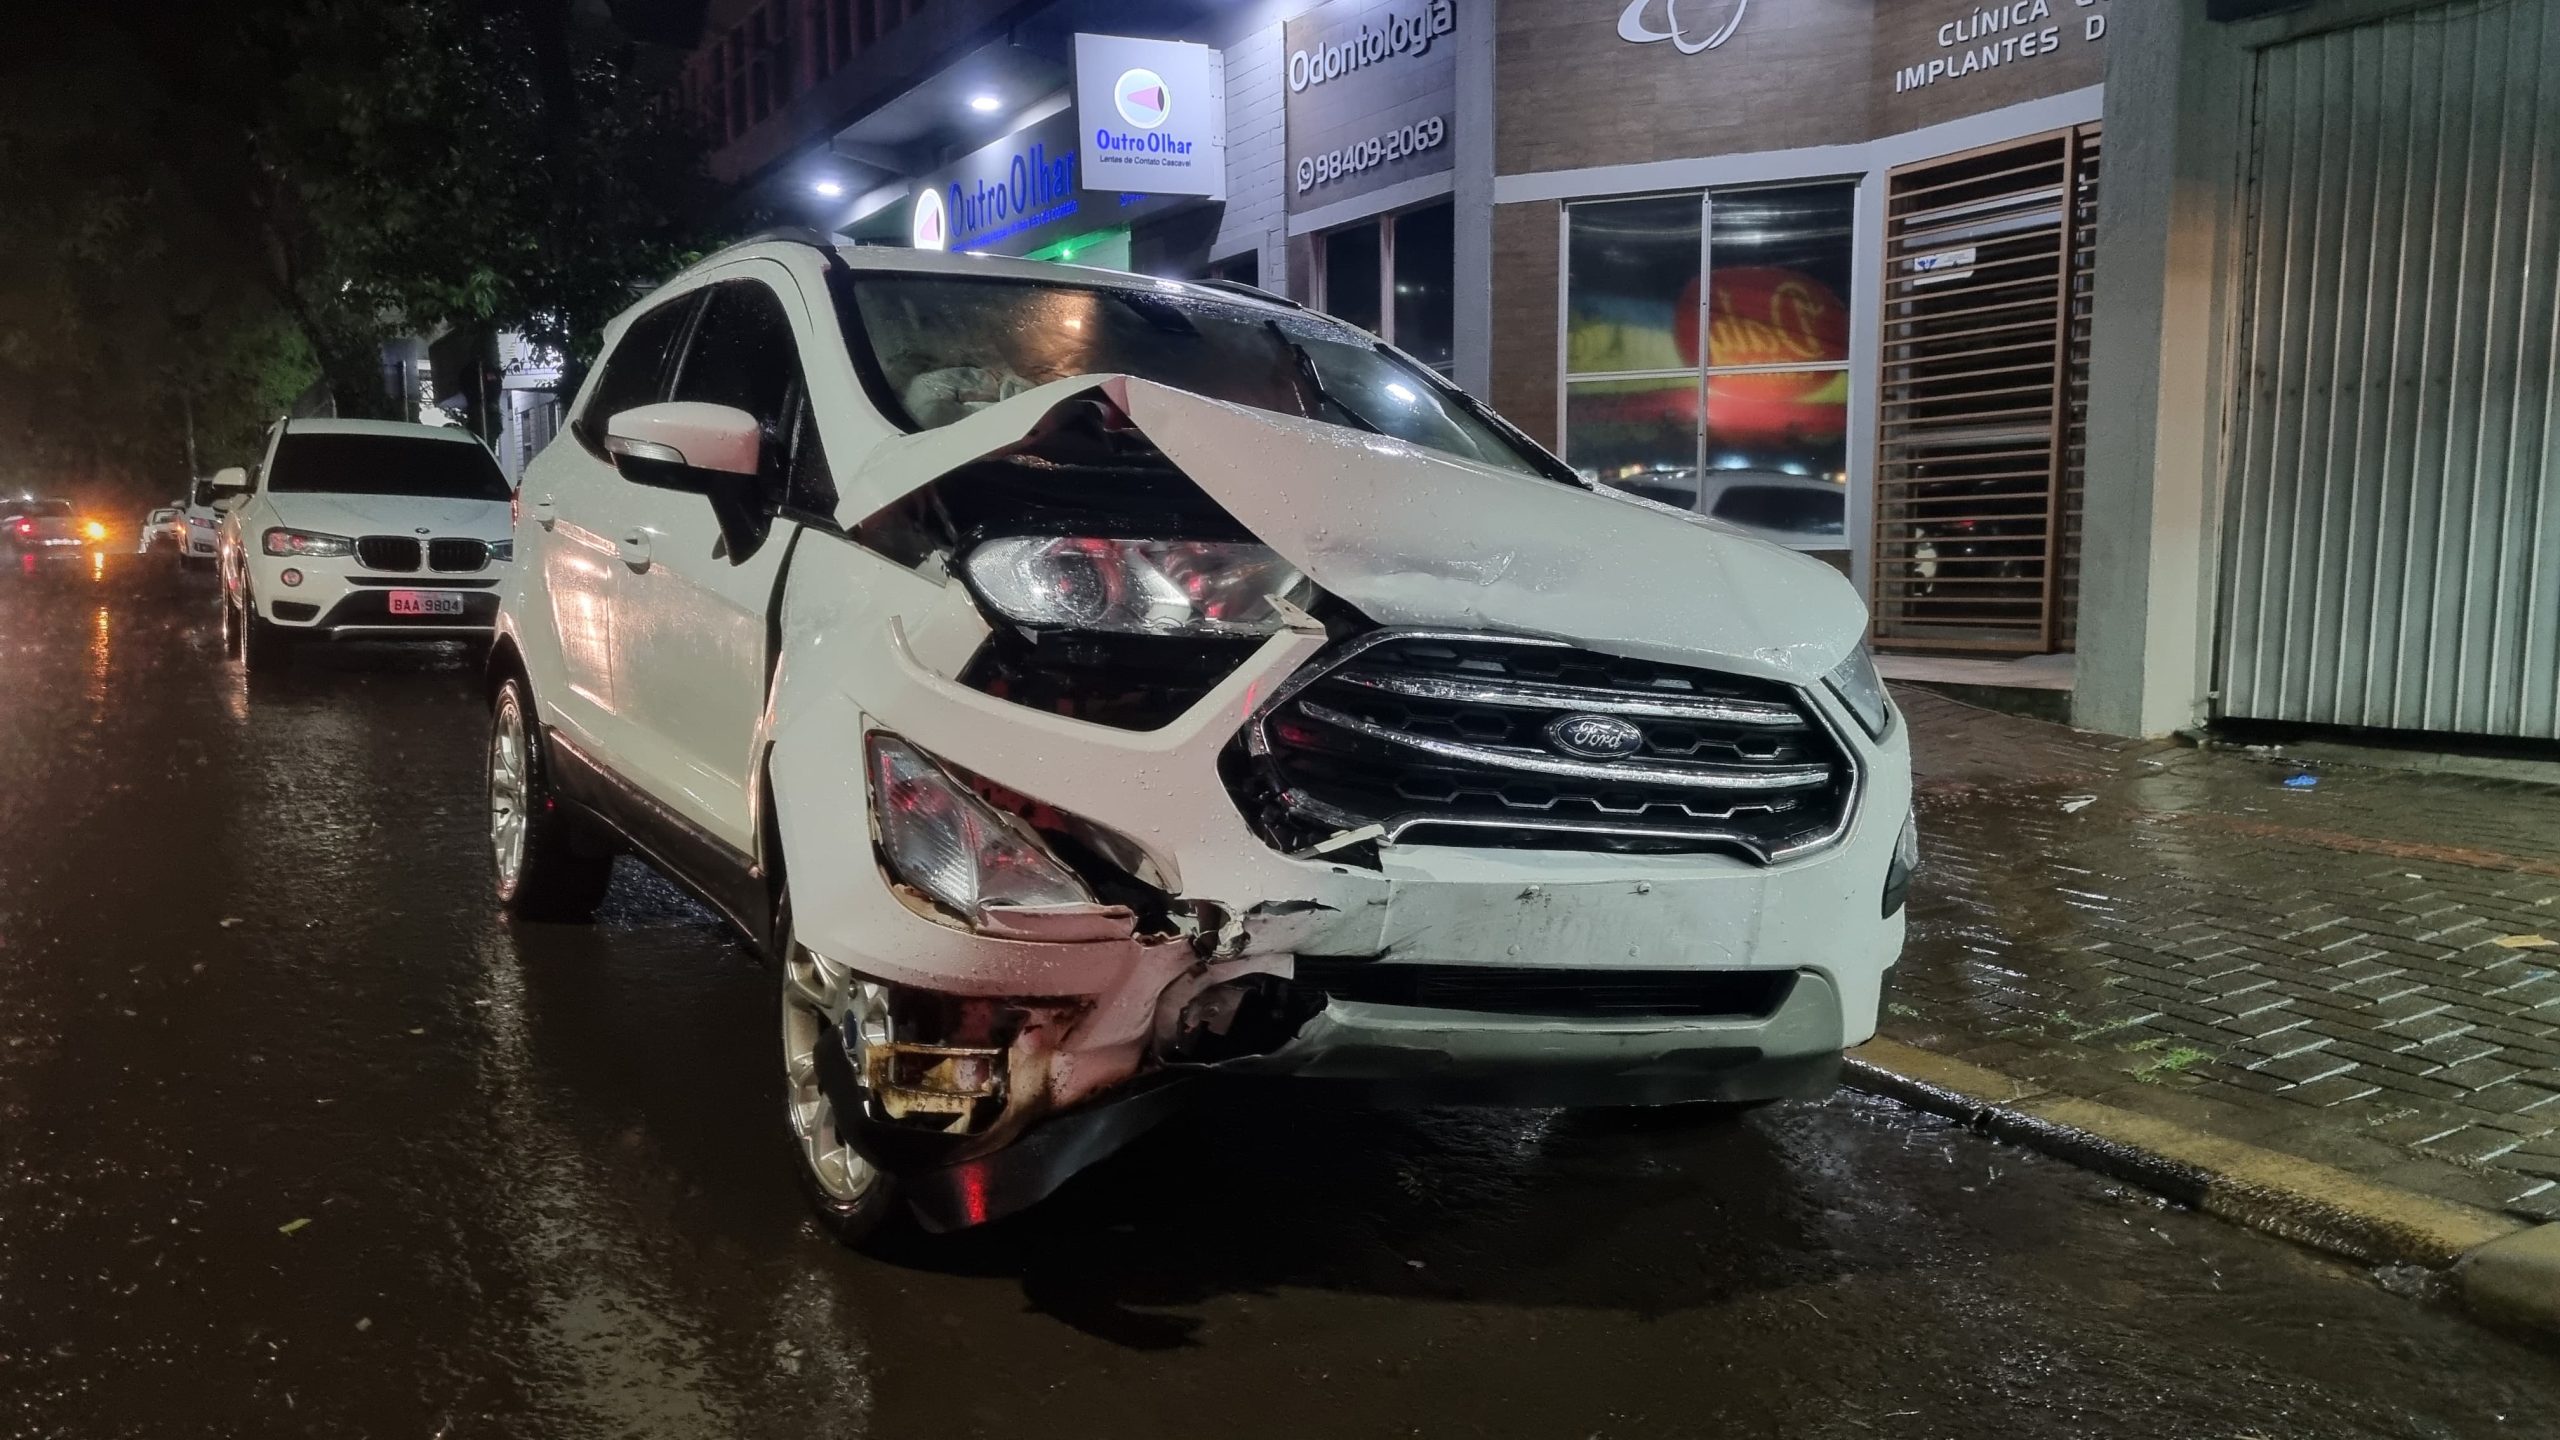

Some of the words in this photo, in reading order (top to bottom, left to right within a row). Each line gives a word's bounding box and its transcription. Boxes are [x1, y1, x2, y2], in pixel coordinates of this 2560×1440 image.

[1289, 0, 1453, 92] Odontologia
[1937, 0, 2050, 47] CLÍNICA
[1895, 26, 2059, 93] IMPLANTES
[1100, 155, 1122, 164] Lentes
[1134, 157, 1160, 166] Contato
[1315, 116, 1444, 184] 98409-2069
[394, 599, 420, 611] BAA
[425, 600, 459, 611] 9804
[1574, 721, 1624, 748] Ford
